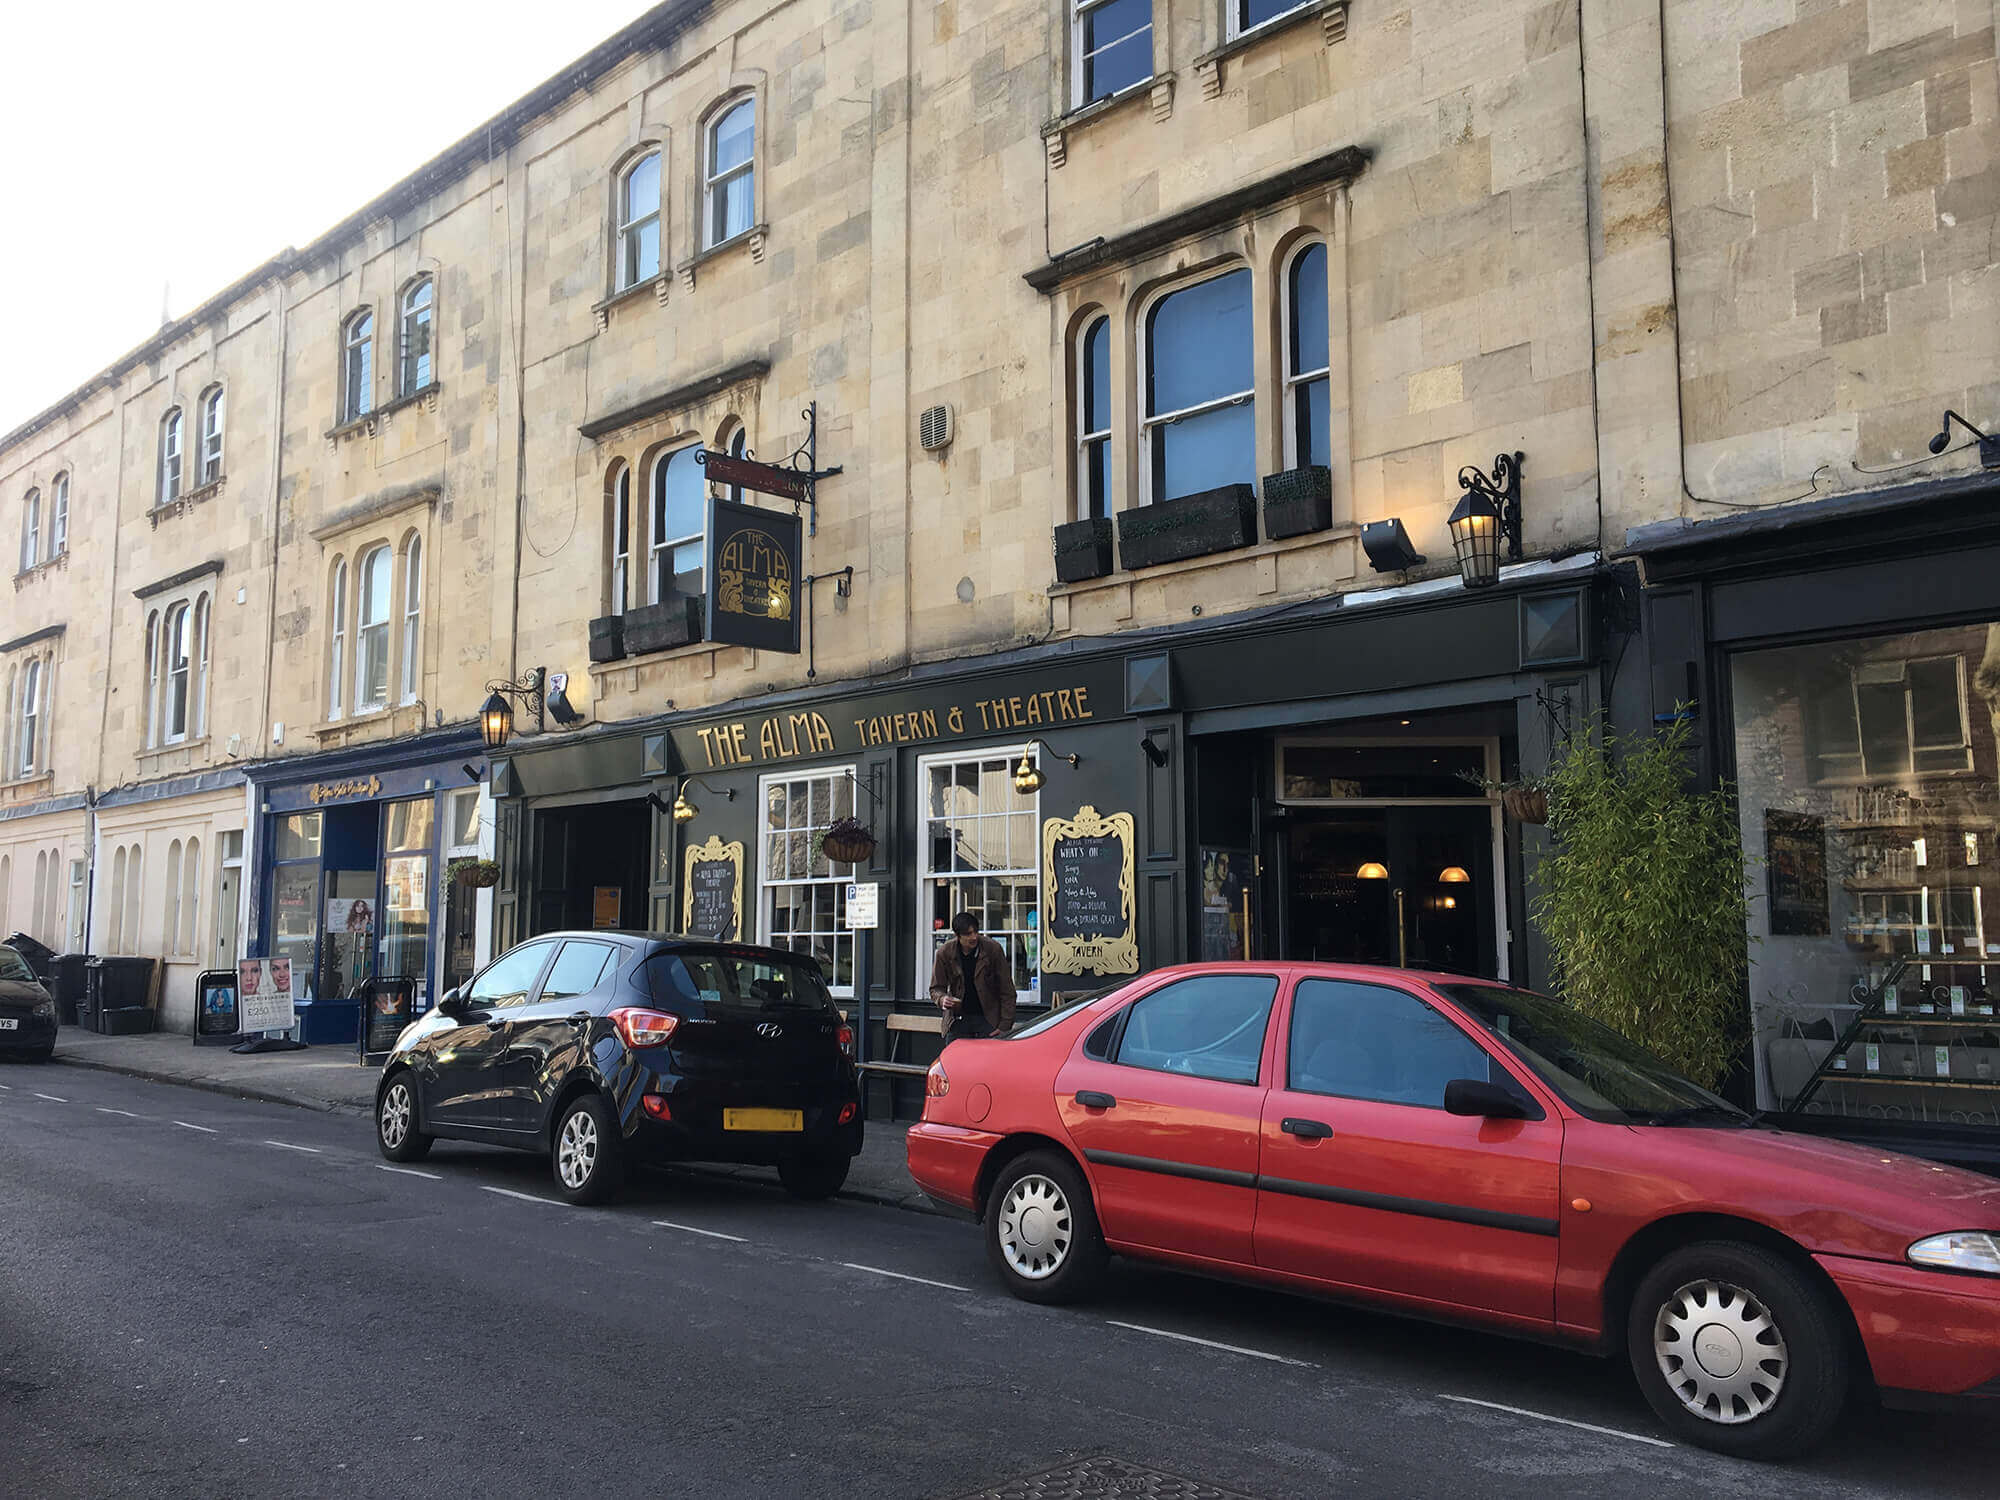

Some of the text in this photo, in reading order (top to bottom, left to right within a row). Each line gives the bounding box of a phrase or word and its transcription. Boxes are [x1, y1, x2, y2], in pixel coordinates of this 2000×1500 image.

[746, 531, 764, 546] THE
[722, 542, 788, 579] ALMA
[697, 687, 1093, 767] THE ALMA TAVERN & THEATRE
[1060, 846, 1085, 858] WHAT'S
[1071, 945, 1103, 958] TAVERN
[247, 1006, 270, 1017] £250
